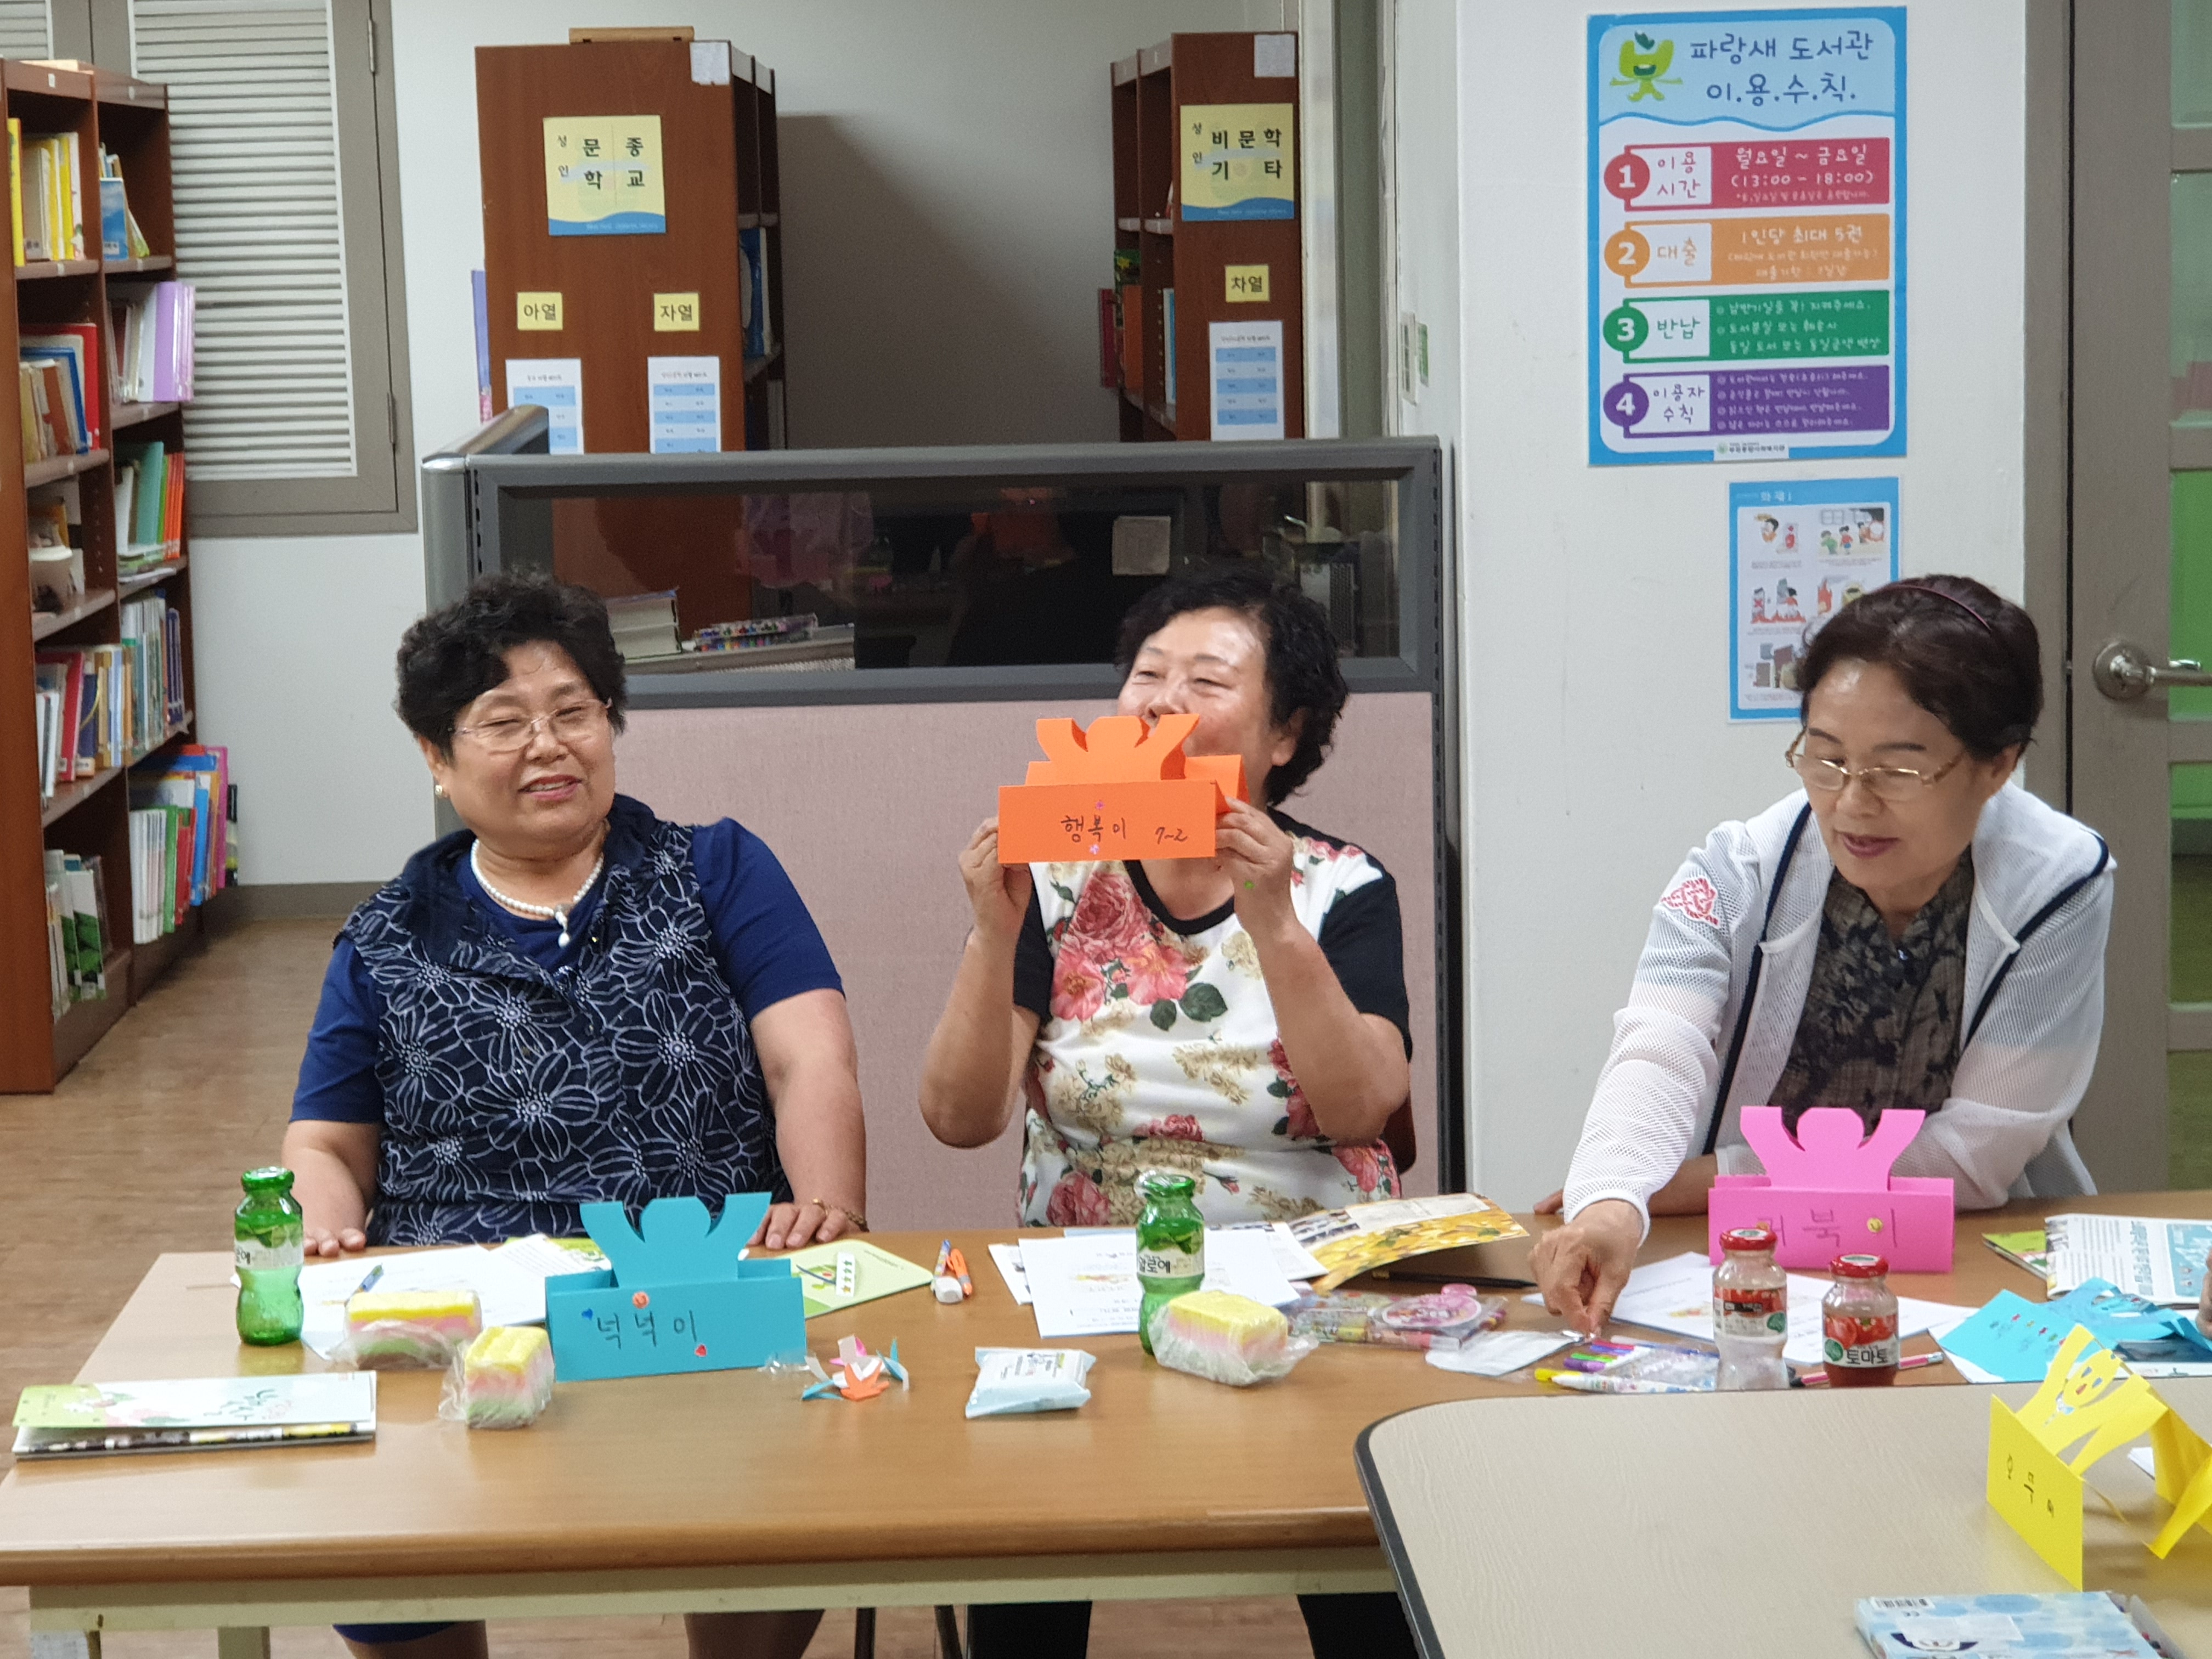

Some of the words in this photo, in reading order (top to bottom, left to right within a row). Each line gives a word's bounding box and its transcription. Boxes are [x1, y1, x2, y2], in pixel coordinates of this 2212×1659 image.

[1690, 33, 1776, 64] 파랑새
[1788, 30, 1873, 60] 도서관
[1211, 127, 1283, 149] 비문학
[1657, 151, 1696, 174] 이용
[1736, 146, 1787, 170] 월요일
[1818, 144, 1867, 166] 금요일
[1619, 165, 1635, 188] 1
[1816, 170, 1874, 185] 18:00)
[1657, 178, 1701, 199] 시간
[1618, 242, 1636, 264] 2
[1657, 238, 1697, 266] 대출
[1231, 276, 1263, 293] 차열
[523, 303, 557, 322] 아열
[660, 303, 693, 322] 자열
[1617, 318, 1635, 341] 3
[1657, 317, 1701, 340] 반납
[1653, 385, 1705, 399] 이용자
[1616, 393, 1636, 416] 4
[1663, 405, 1694, 425] 수칙
[1060, 815, 1126, 843] 행복이
[1846, 1349, 1889, 1365] 토마토
